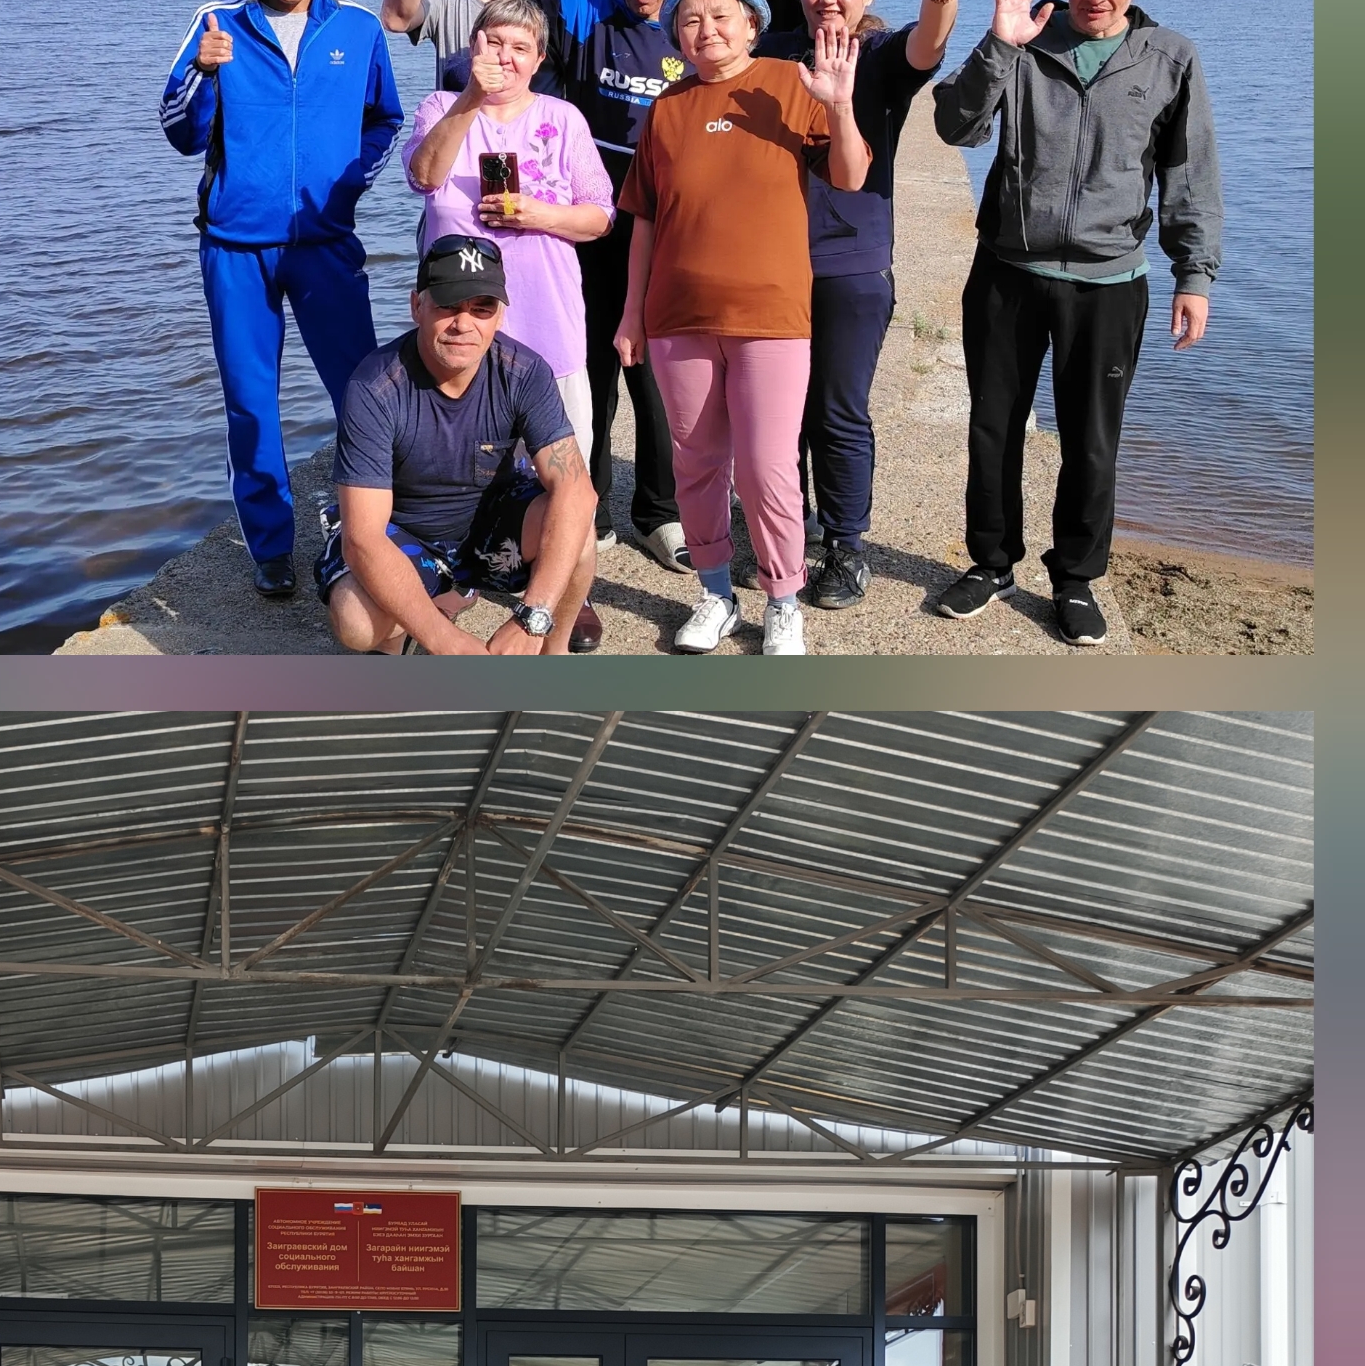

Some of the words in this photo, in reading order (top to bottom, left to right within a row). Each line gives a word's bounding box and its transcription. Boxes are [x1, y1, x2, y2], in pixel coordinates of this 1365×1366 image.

[608, 91, 641, 104] RUSSIA
[706, 118, 733, 133] alo
[266, 1241, 328, 1252] Заиграевский
[330, 1243, 348, 1252] дом
[366, 1243, 407, 1253] Загарайн
[408, 1244, 450, 1253] ниигэмэй
[278, 1253, 336, 1261] социального
[394, 1254, 444, 1263] хангамжын
[275, 1262, 340, 1272] обслуживания
[391, 1263, 425, 1272] байшан
